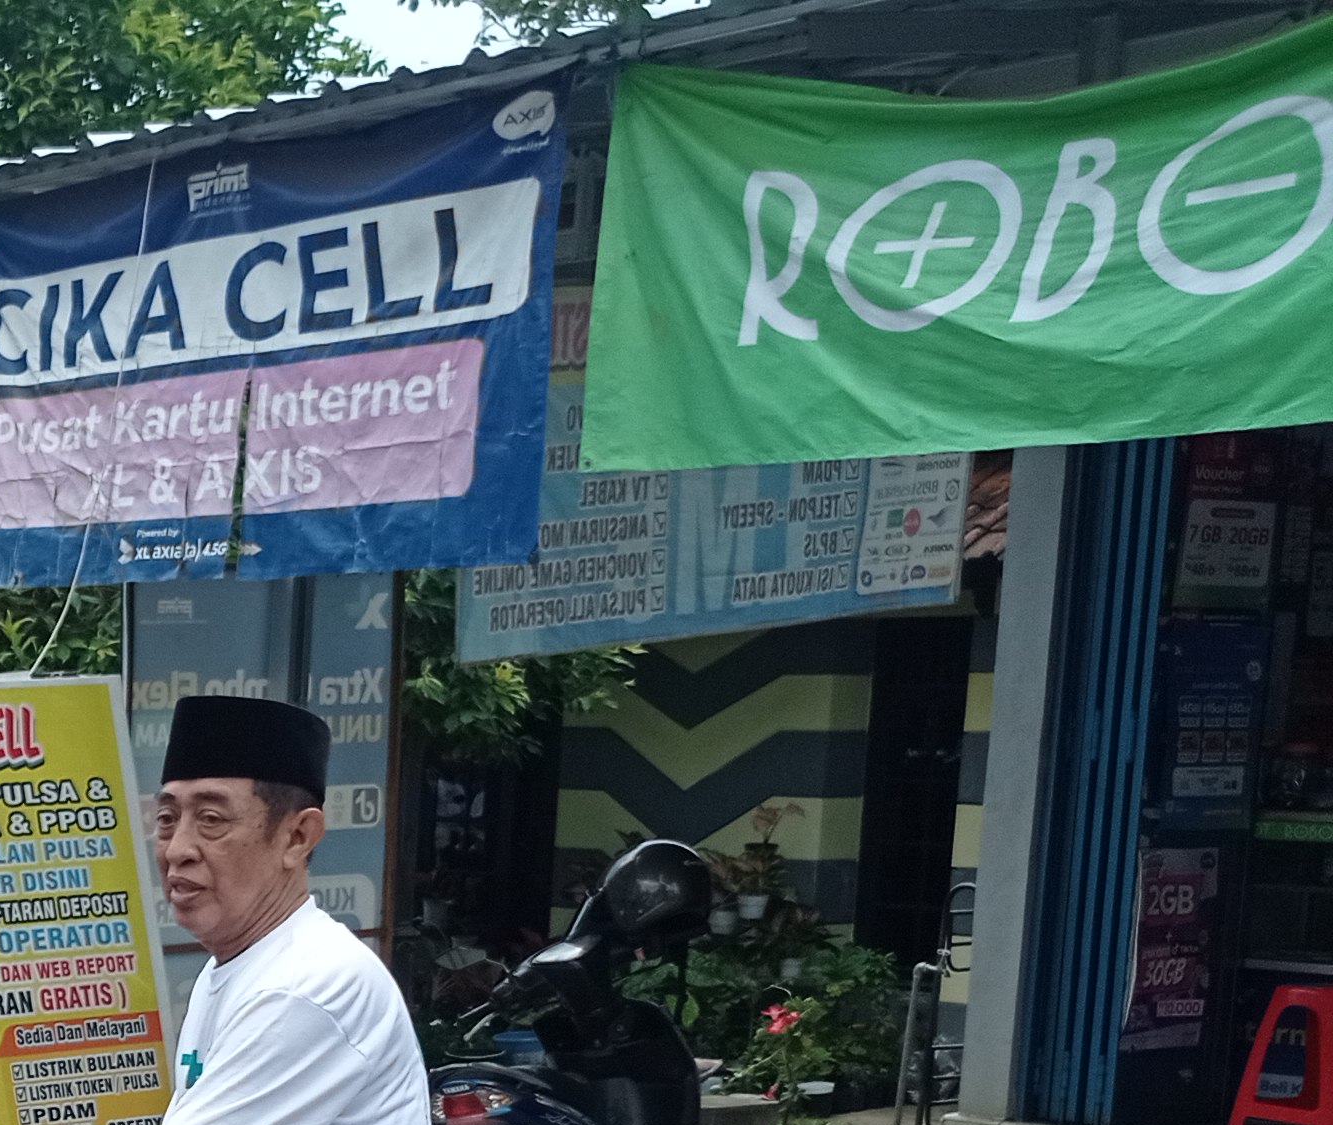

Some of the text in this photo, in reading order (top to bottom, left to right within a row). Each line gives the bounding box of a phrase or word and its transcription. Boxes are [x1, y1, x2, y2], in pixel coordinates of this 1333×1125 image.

[224, 207, 494, 342] CELL
[112, 391, 235, 445] Kartu
[256, 359, 458, 432] Internet
[82, 445, 322, 511] XL & AXIS
[136, 528, 180, 538] Powered by
[134, 547, 150, 561] XL
[87, 777, 110, 801] &
[9, 811, 30, 836] &
[39, 806, 117, 834] PPOB
[44, 836, 114, 861] PULSA
[22, 867, 90, 892] DISINI
[60, 893, 128, 919] DEPOSIT
[1146, 884, 1194, 916] 2GB
[0, 961, 33, 983] DAN
[36, 957, 72, 980] WEB
[76, 954, 135, 976] REPORT
[1142, 957, 1187, 988] 30GB
[39, 982, 113, 1012] GRATIS
[15, 1017, 146, 1046] Sedia Dan Melayani
[25, 1050, 156, 1079] LISTRIK BULANAN
[29, 1083, 74, 1102] LISTRIK
[75, 1078, 113, 1096] TOKEN
[124, 1072, 160, 1091] PULSA
[33, 1101, 97, 1124] PDAM
